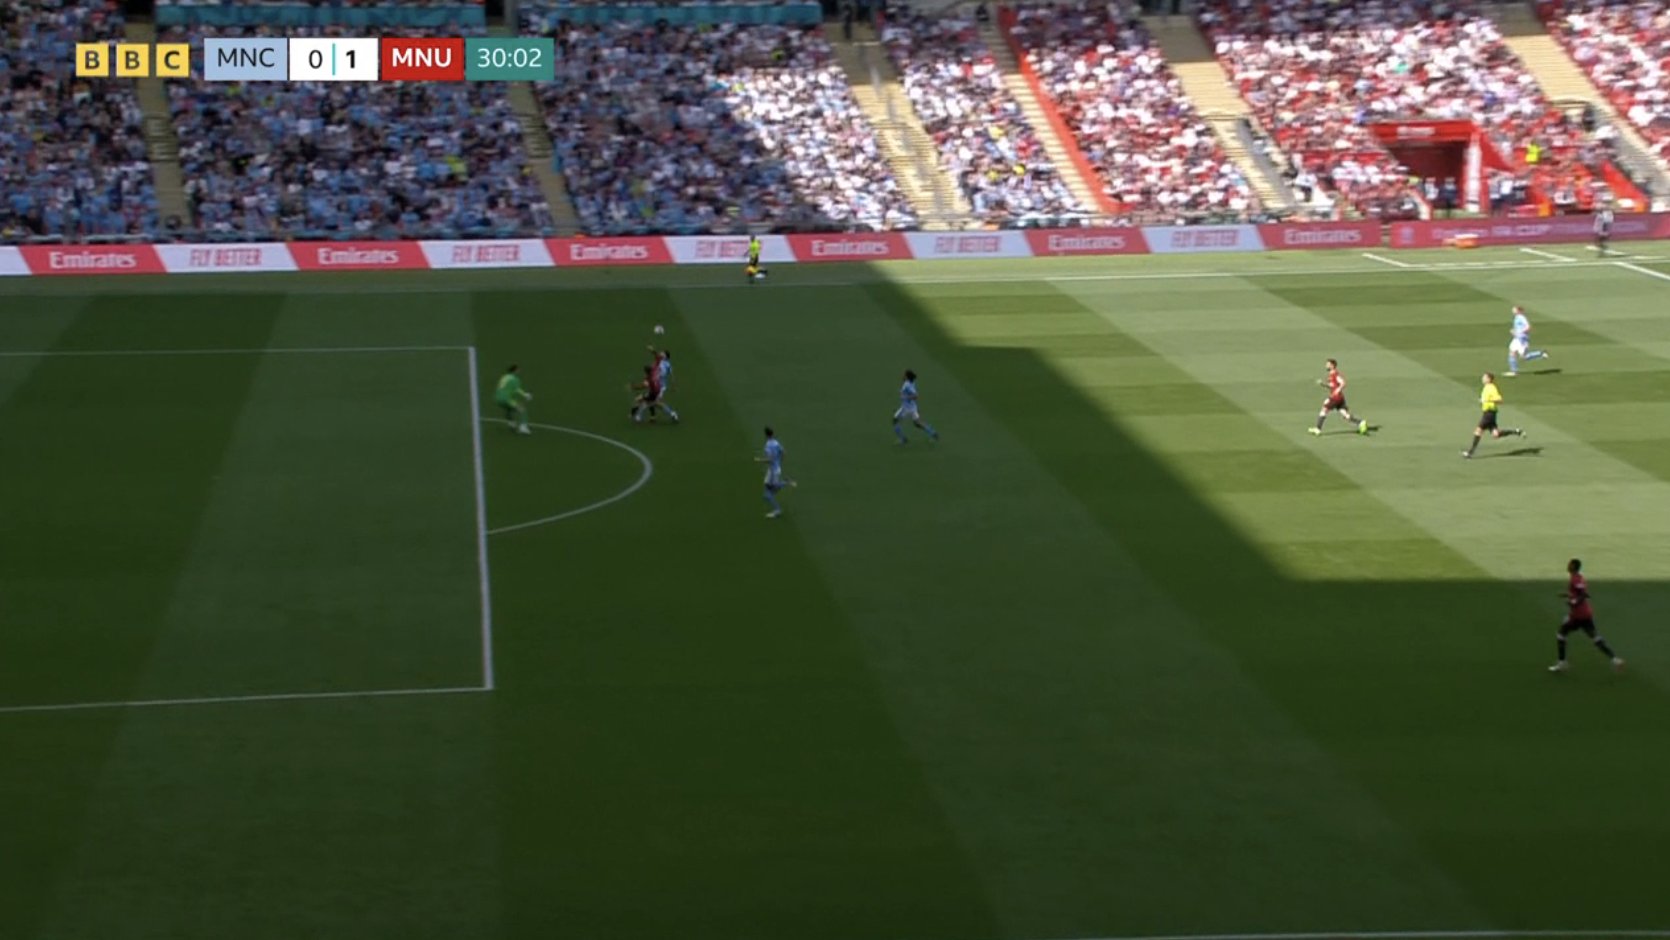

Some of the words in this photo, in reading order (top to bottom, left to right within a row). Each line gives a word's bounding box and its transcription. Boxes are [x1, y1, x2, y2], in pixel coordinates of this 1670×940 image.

[1047, 234, 1127, 251] Emirates
[1284, 228, 1361, 245] Emirates
[317, 247, 400, 265] Emirates
[570, 244, 649, 260] Emirates
[811, 239, 889, 256] Emirates
[48, 251, 137, 269] Emirates
